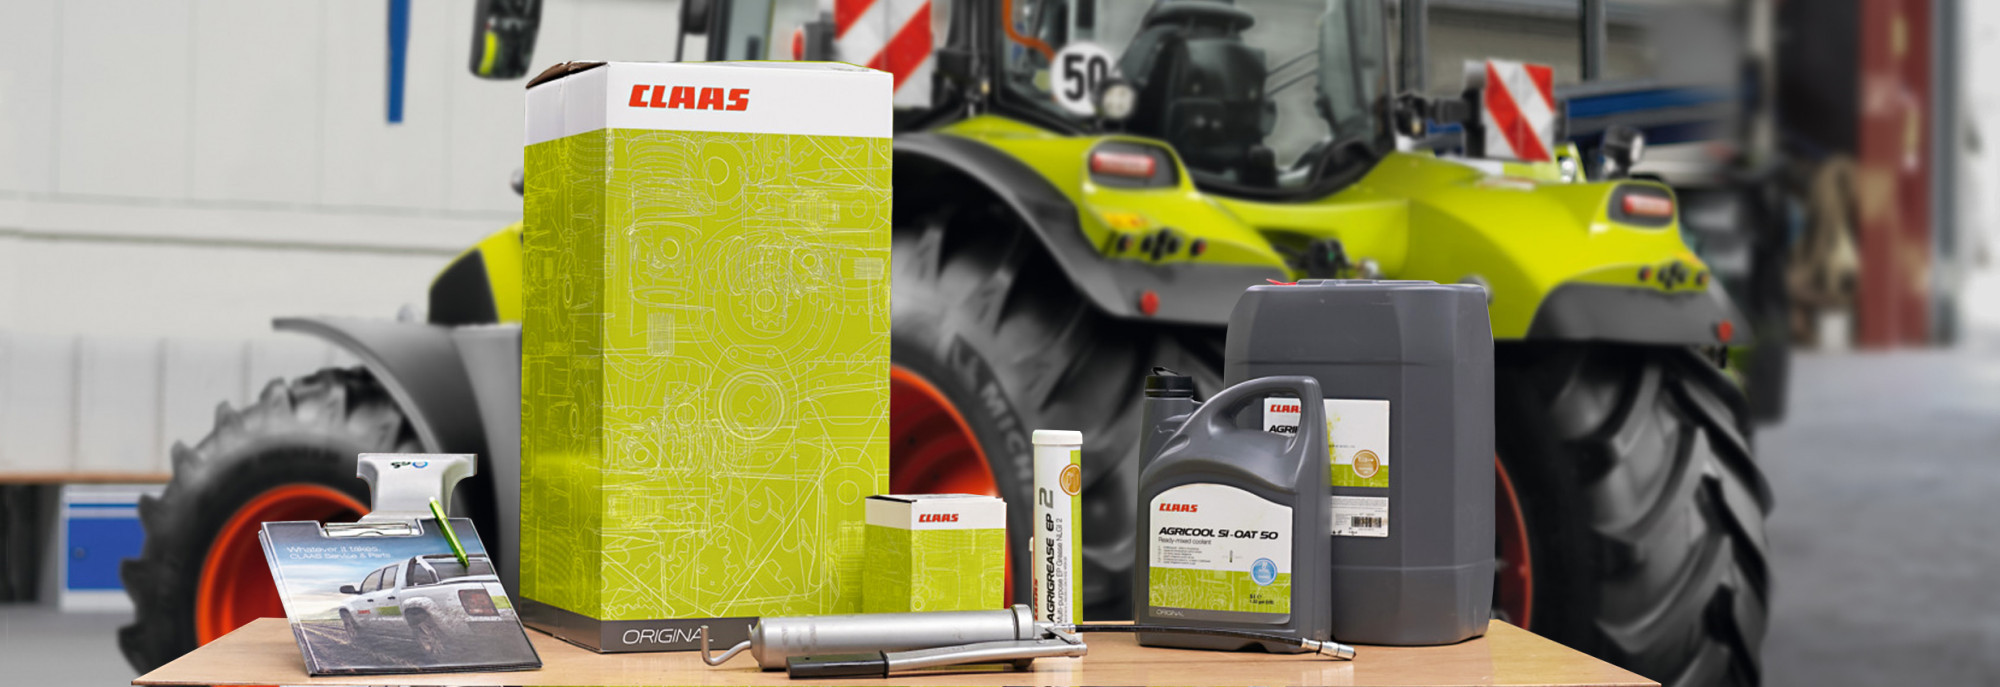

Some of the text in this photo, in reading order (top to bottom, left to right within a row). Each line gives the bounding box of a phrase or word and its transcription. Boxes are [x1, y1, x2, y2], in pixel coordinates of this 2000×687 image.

[1064, 54, 1108, 102] 50
[629, 84, 750, 111] CLAAS
[1270, 404, 1301, 413] CLAA
[1269, 425, 1298, 434] AGRI
[1159, 503, 1198, 512] CLAAS
[919, 513, 959, 522] CLAAS
[1159, 527, 1215, 538] AGRICOOL
[1259, 531, 1279, 540] 50
[1039, 487, 1054, 623] AGRIGREASE EP 2
[1056, 567, 1063, 577] EP
[1156, 609, 1184, 617] ORIGINAL
